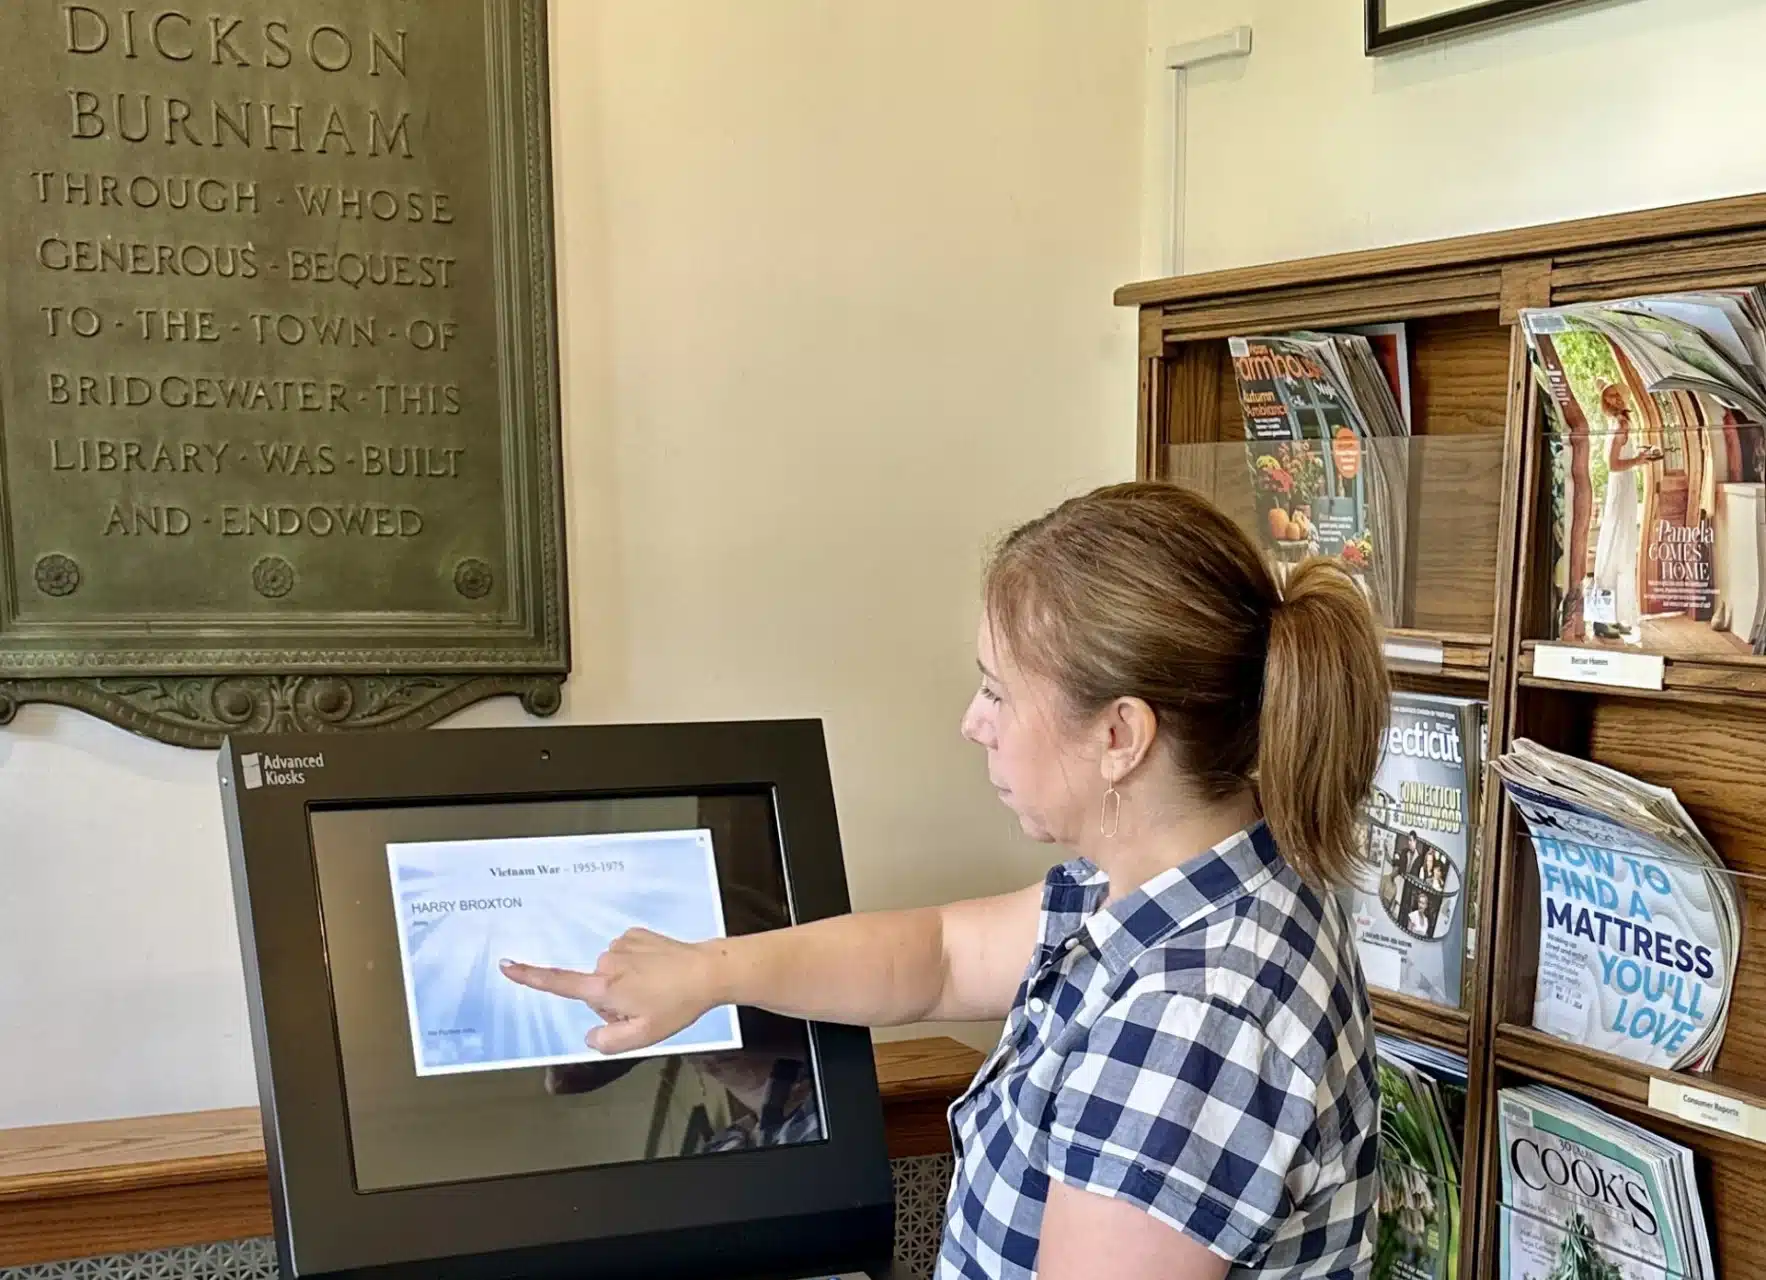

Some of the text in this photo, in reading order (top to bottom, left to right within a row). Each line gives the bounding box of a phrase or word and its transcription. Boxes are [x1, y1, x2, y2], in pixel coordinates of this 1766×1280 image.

[62, 4, 408, 78] DICKSON
[66, 89, 414, 160] BURNHAM
[30, 170, 456, 225] THROUGH WHOSE
[36, 236, 457, 290] GENEROUS BEQUEST
[40, 306, 459, 352] TO THE TOWN OF
[46, 373, 462, 415] BRIDGEWATER THIS
[49, 437, 465, 478] LIBRARY WAS BUILT
[103, 504, 425, 538] AND ENDOWED
[1653, 519, 1714, 544] Pamela
[1648, 542, 1702, 562] COMES
[1661, 561, 1710, 581] HOME
[264, 752, 325, 770] Advanced
[1382, 721, 1462, 764] ecticut
[265, 769, 306, 785] Kiosks
[490, 866, 536, 878] Vietnam
[537, 864, 561, 875] War
[1537, 829, 1615, 878] HOW
[1621, 855, 1672, 895] TO
[411, 897, 523, 915] HARRY BROXTON
[1542, 862, 1652, 923] FIND A
[1546, 896, 1714, 979] MATTRESS
[1598, 951, 1705, 1020] YOU'LL
[1612, 998, 1696, 1053] LOVE
[1682, 1093, 1713, 1110] Consumer
[1713, 1101, 1740, 1117] Reports
[1511, 1137, 1658, 1236] COOK'S
